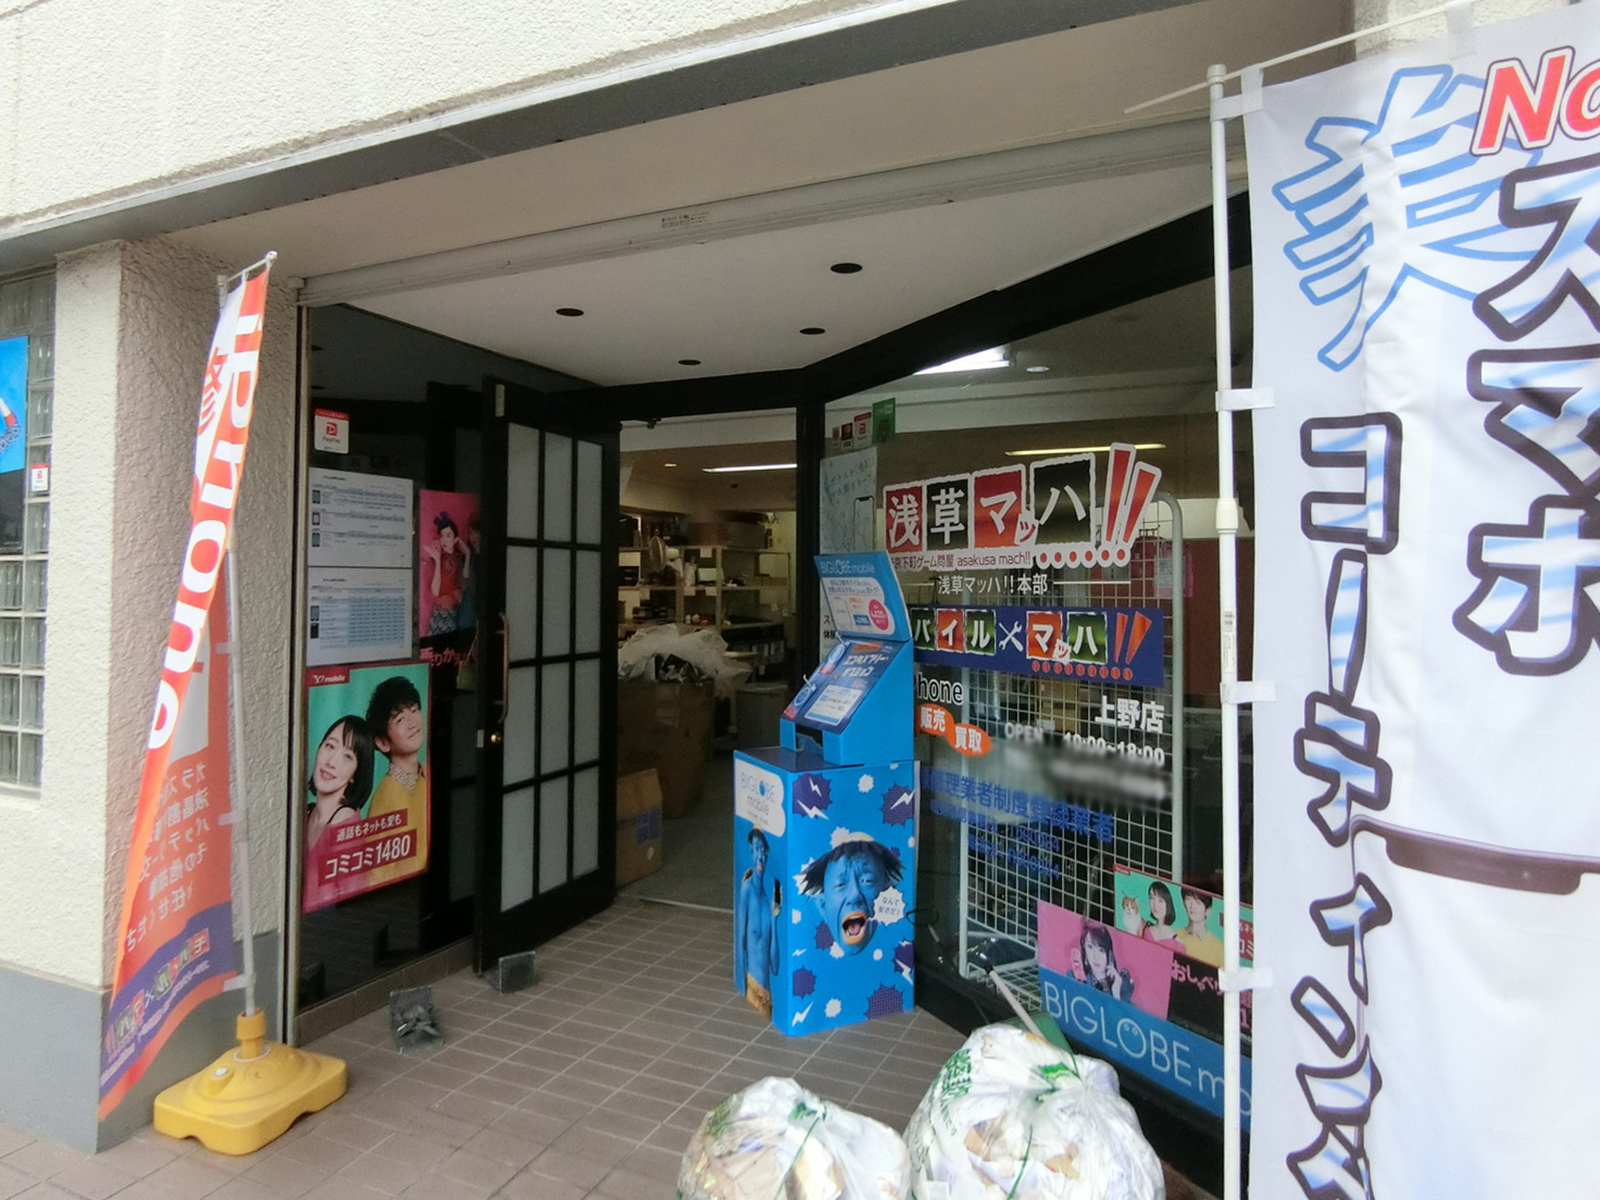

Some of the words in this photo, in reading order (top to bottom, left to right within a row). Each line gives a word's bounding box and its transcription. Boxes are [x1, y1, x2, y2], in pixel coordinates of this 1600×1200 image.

[891, 553, 954, 571] 京下町ゲーム問屋
[957, 554, 996, 567] asakusa
[913, 671, 964, 706] hone
[920, 706, 946, 732] 販売
[1095, 695, 1165, 734] 上野店
[954, 725, 983, 753] 買取
[1004, 721, 1044, 743] OPEN
[324, 834, 411, 880] コミコミ1480
[1044, 981, 1193, 1087] BIGLOBE
